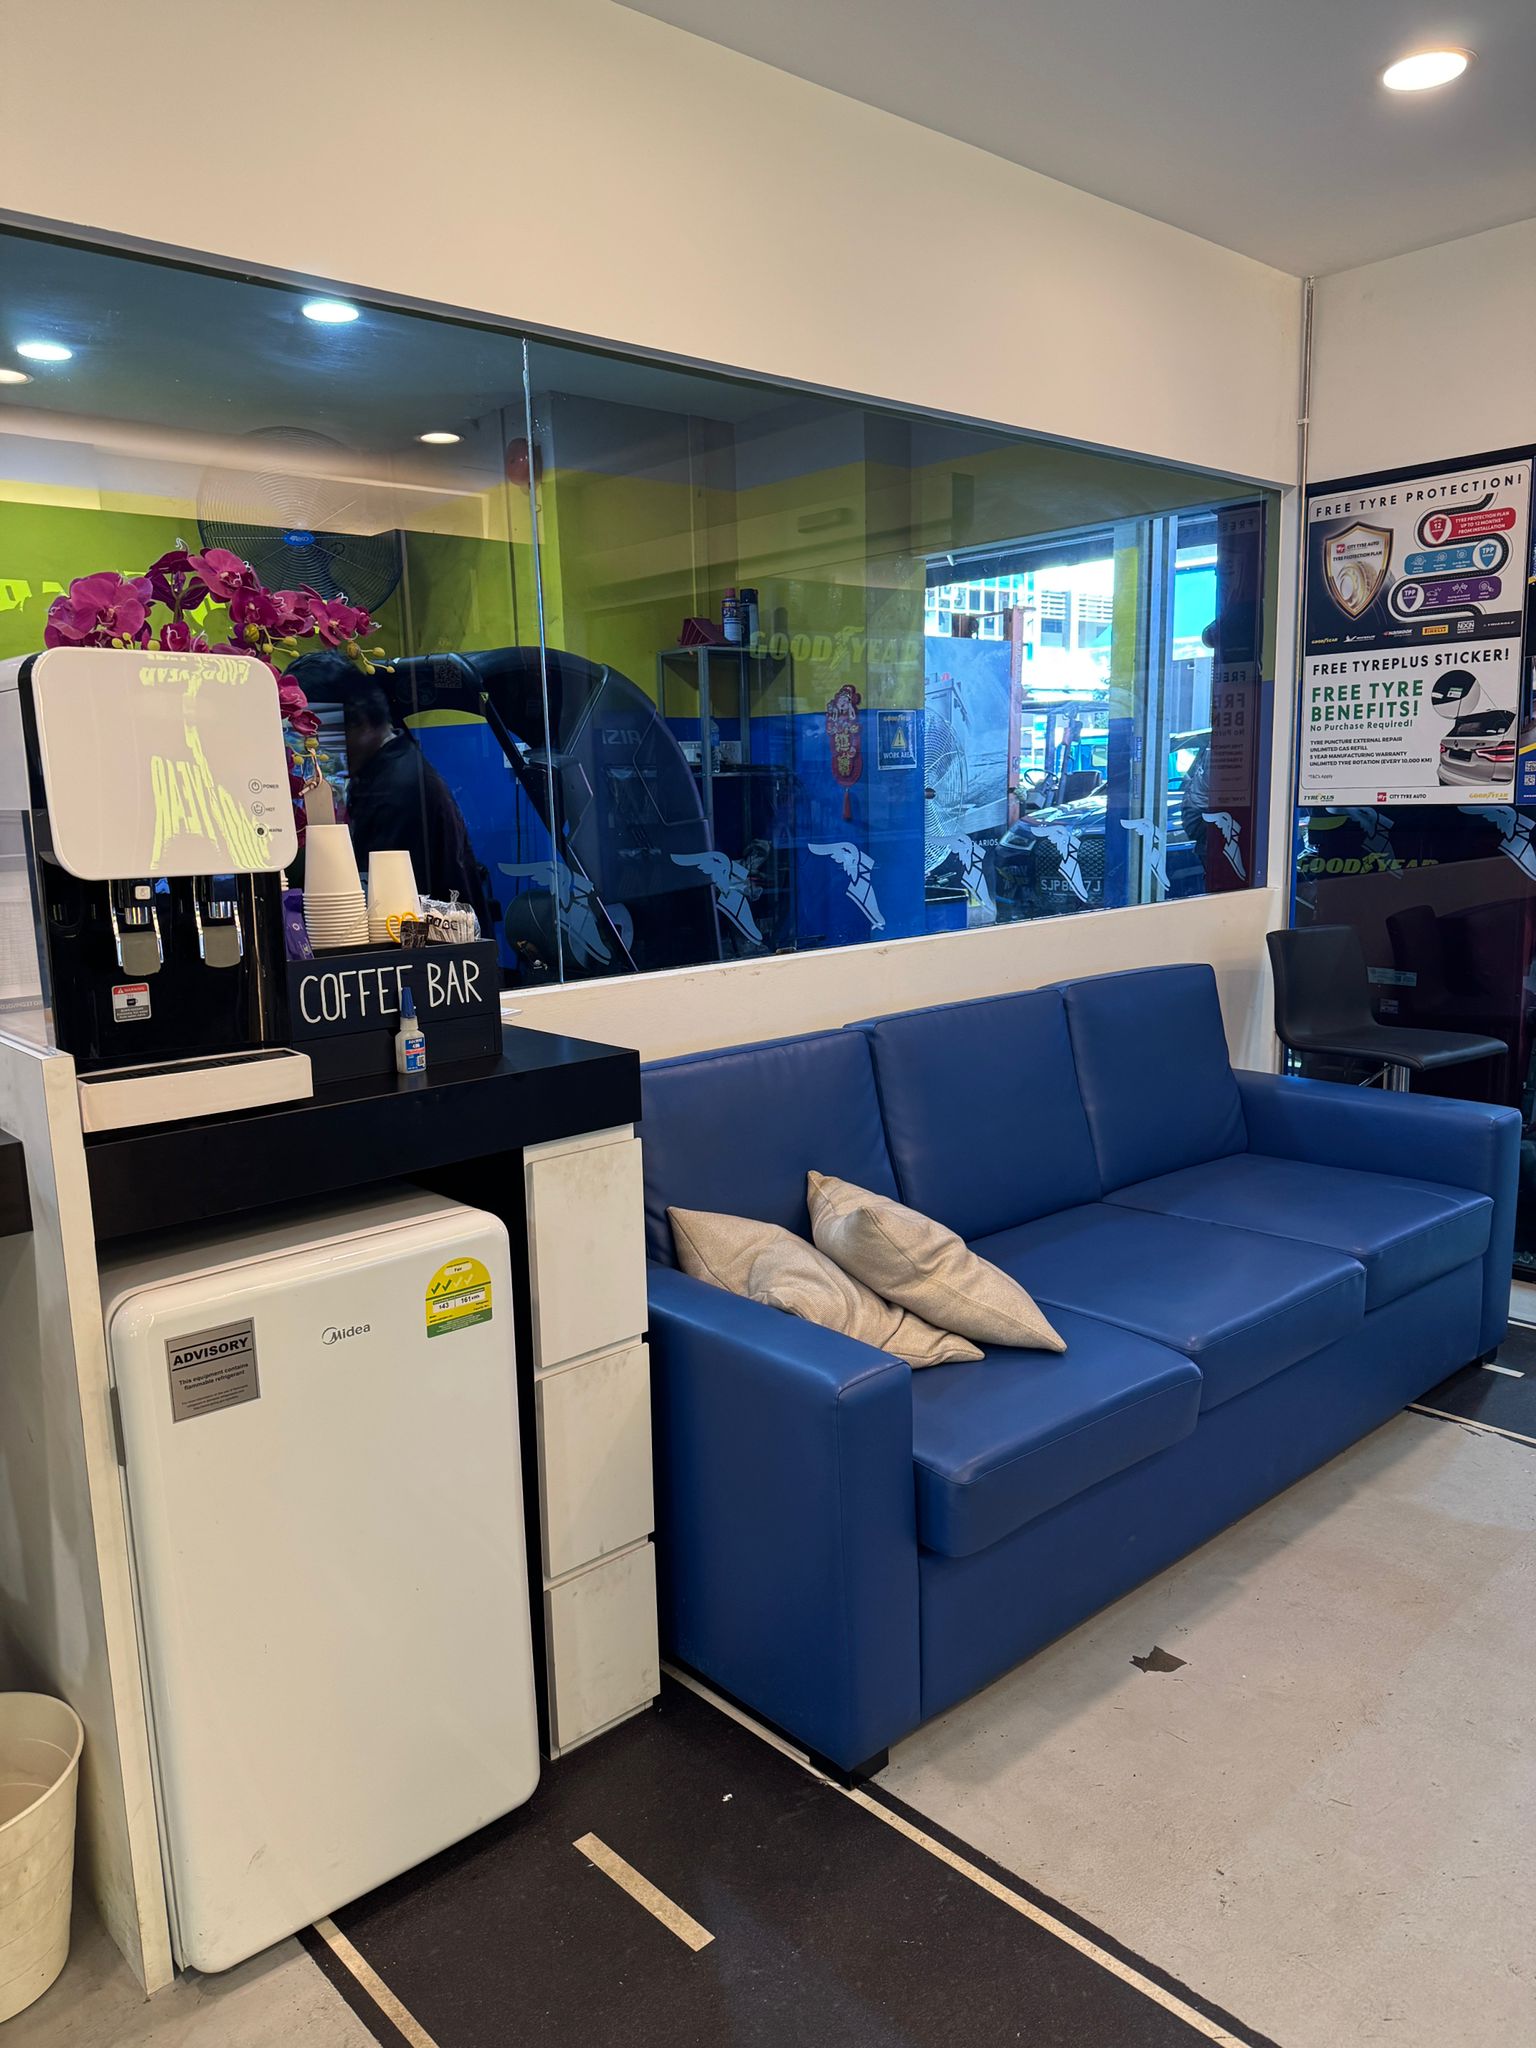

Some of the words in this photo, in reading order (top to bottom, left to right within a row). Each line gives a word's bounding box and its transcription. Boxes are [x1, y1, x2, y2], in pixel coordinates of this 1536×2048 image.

[1316, 503, 1351, 517] FREE
[1360, 495, 1397, 510] TYRE
[1406, 474, 1521, 502] PROTECTION!
[1467, 513, 1496, 522] PROTECTION
[1472, 524, 1506, 532] INSTALLATION
[1344, 552, 1370, 560] PROTECTION
[1482, 546, 1494, 554] TPP
[750, 630, 920, 665] GOODYEAR
[1313, 662, 1347, 676] FREE
[1353, 655, 1429, 673] TYREPLUS
[1435, 648, 1509, 665] STICKER!
[1312, 684, 1361, 703] FREE
[1369, 680, 1423, 699] TYRE
[1311, 700, 1418, 722] BENEFITS!
[1310, 724, 1322, 732] No
[1324, 721, 1364, 731] Purchase
[1367, 719, 1413, 730] Required!
[1041, 879, 1101, 892] SJP87J
[427, 959, 482, 1008] BAR
[326, 1324, 371, 1344] Midea
[173, 1337, 248, 1366] ADVISORY
[179, 1378, 192, 1386] This
[192, 1369, 224, 1383] equipment
[224, 1363, 249, 1374] contains
[184, 1378, 214, 1391] flammable
[215, 1369, 245, 1382] refrigerant
